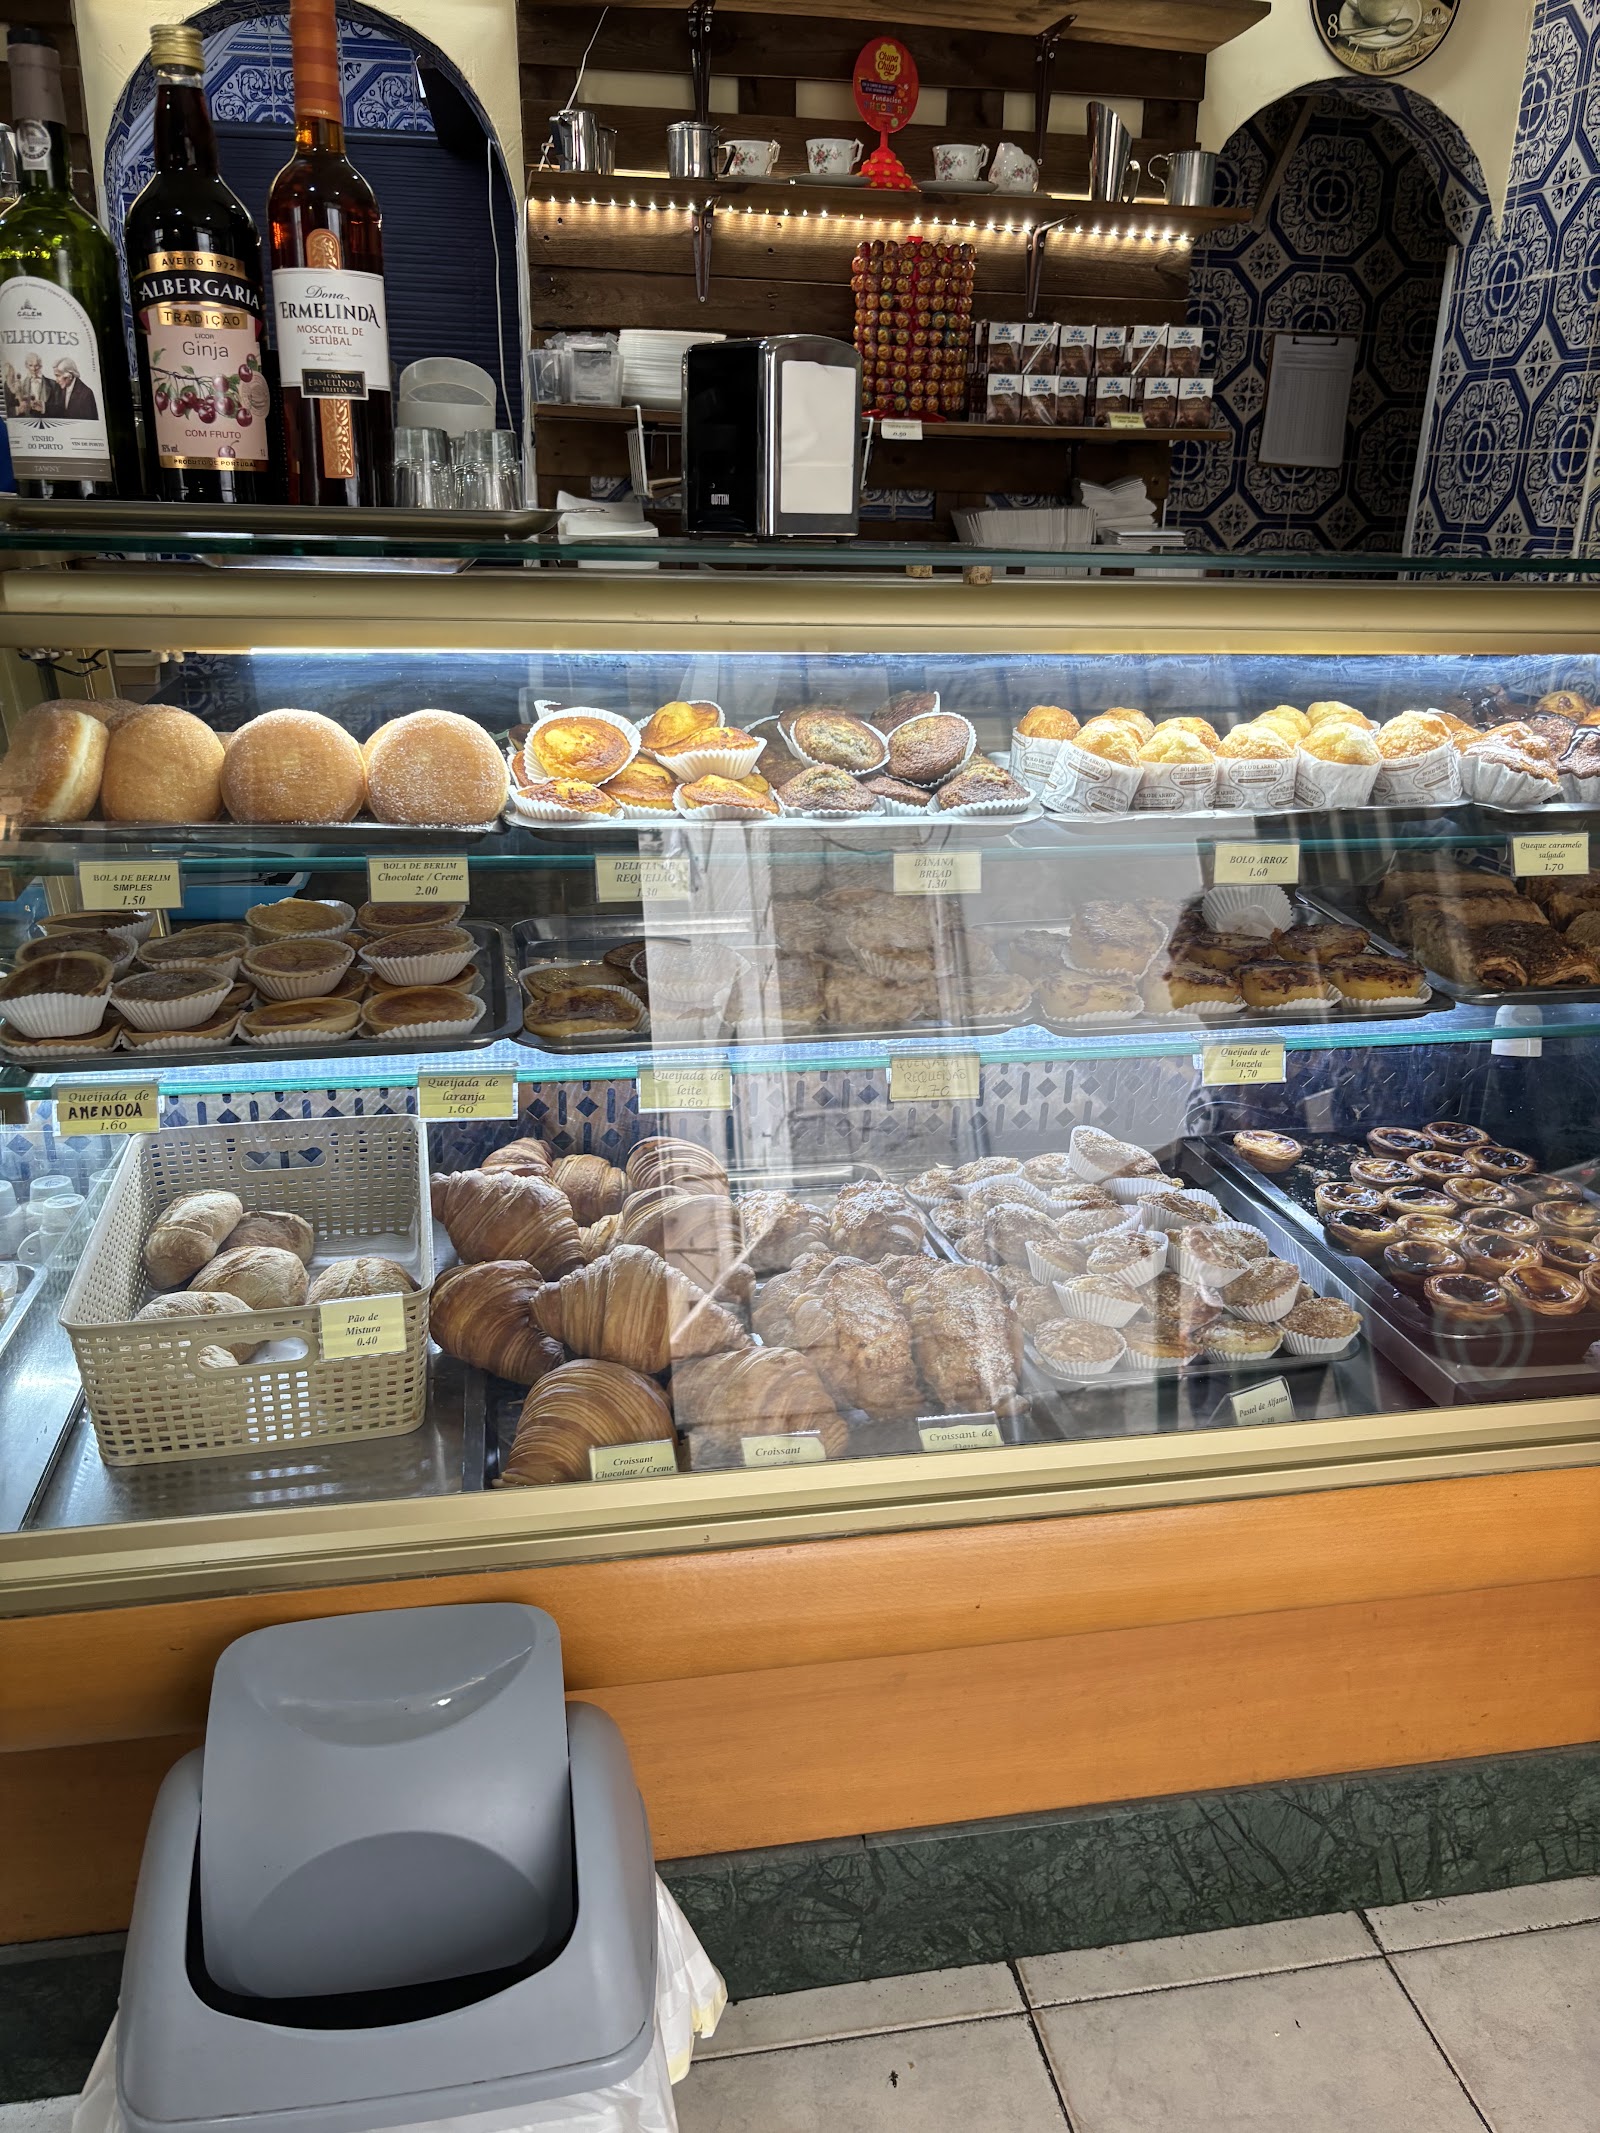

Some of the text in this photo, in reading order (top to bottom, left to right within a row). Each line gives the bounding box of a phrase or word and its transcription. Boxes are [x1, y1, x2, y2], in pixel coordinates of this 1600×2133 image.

[1327, 13, 1338, 38] 8
[878, 52, 899, 62] Chupa
[877, 61, 898, 74] Chups
[161, 258, 236, 271] AVEIRO 1972
[139, 278, 260, 310] ALBERGARIA
[305, 285, 350, 300] Dona
[280, 301, 381, 329] ERMELINDA
[297, 325, 364, 336] MOSCATEL DE
[182, 341, 229, 361] Ginja
[308, 378, 362, 388] ERMELINDA
[32, 435, 54, 443] VINHO
[185, 429, 241, 439] COM FRUTO
[34, 465, 61, 473] TAWNY
[1520, 841, 1582, 850] Queque caramelo
[1229, 856, 1289, 864] BOLO ARROZ
[1539, 851, 1566, 860] salgado
[423, 862, 457, 870] BERLIM
[914, 858, 954, 867] BANANA
[1544, 863, 1564, 872] 1.70
[94, 874, 171, 882] BOLA DE BERLIM
[378, 873, 425, 881] Chocolate
[434, 873, 464, 881] Creme
[616, 872, 676, 883] REQUEIJÃO
[919, 869, 952, 878] BREAD
[1249, 868, 1268, 877] 1.60
[927, 879, 947, 889] 1.30
[415, 886, 439, 896] 2.00
[637, 887, 658, 898] 1.30
[122, 895, 146, 906] 1.50
[1220, 1047, 1271, 1059] Queijada de
[1230, 1059, 1263, 1068] Vouzela
[653, 1070, 724, 1083] Queijada de
[428, 1077, 499, 1090] Queijada de
[677, 1084, 702, 1095] leite
[68, 1090, 150, 1103] Queijada de
[442, 1091, 486, 1104] laranja
[680, 1097, 703, 1107] 1.60
[68, 1103, 143, 1119] AMENDOA
[448, 1104, 474, 1114] 1.60
[100, 1120, 127, 1131] 1.60
[347, 1313, 379, 1324] Pão de
[346, 1325, 381, 1336] Mistura
[356, 1336, 378, 1347] 0.40
[1239, 1405, 1257, 1418] Pastel
[1258, 1402, 1265, 1411] de
[929, 1428, 993, 1442] Croissant de
[755, 1447, 801, 1457] Croissant
[613, 1456, 653, 1466] Croissant
[595, 1469, 638, 1479] Chocolate
[646, 1465, 674, 1473] Creme
